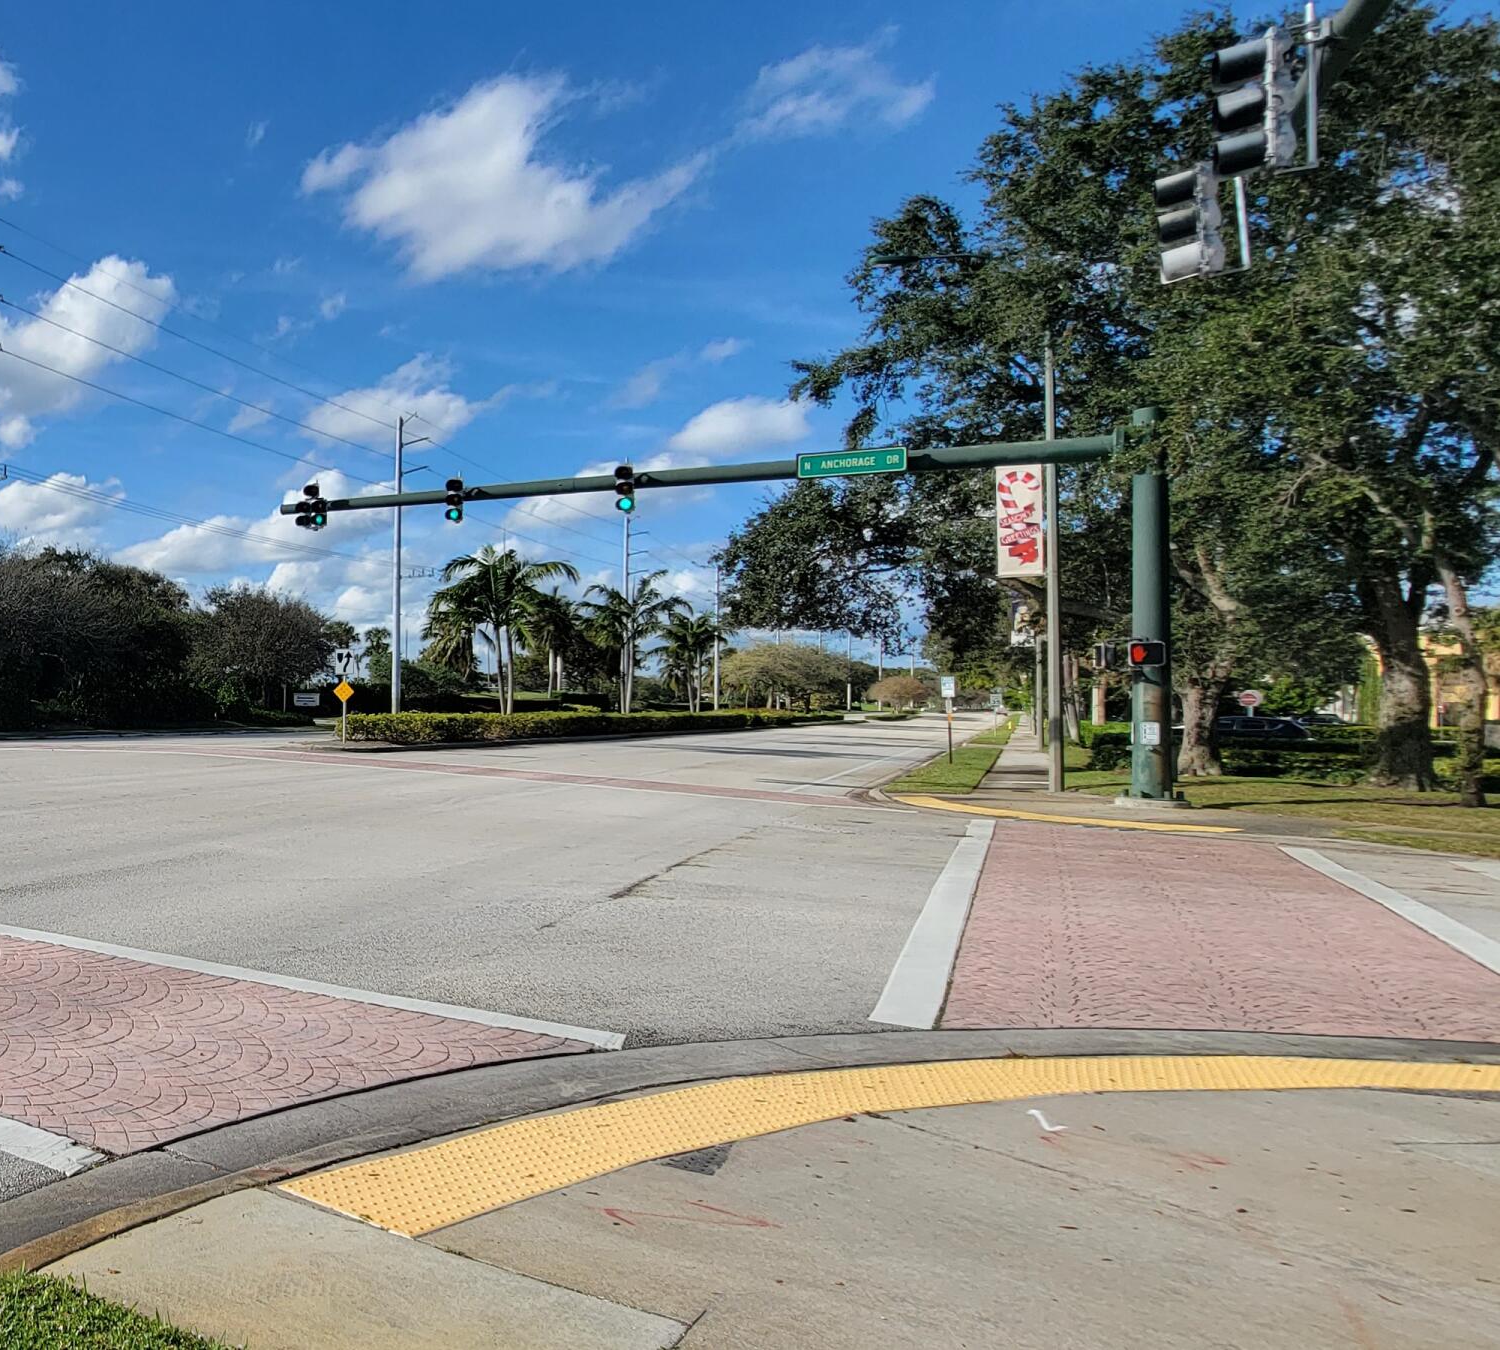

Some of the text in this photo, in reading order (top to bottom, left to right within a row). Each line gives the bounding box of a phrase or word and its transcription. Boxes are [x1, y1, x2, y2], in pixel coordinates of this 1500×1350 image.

[804, 454, 900, 470] N ANCHORAGE DR
[1001, 525, 1040, 544] GREETINGS
